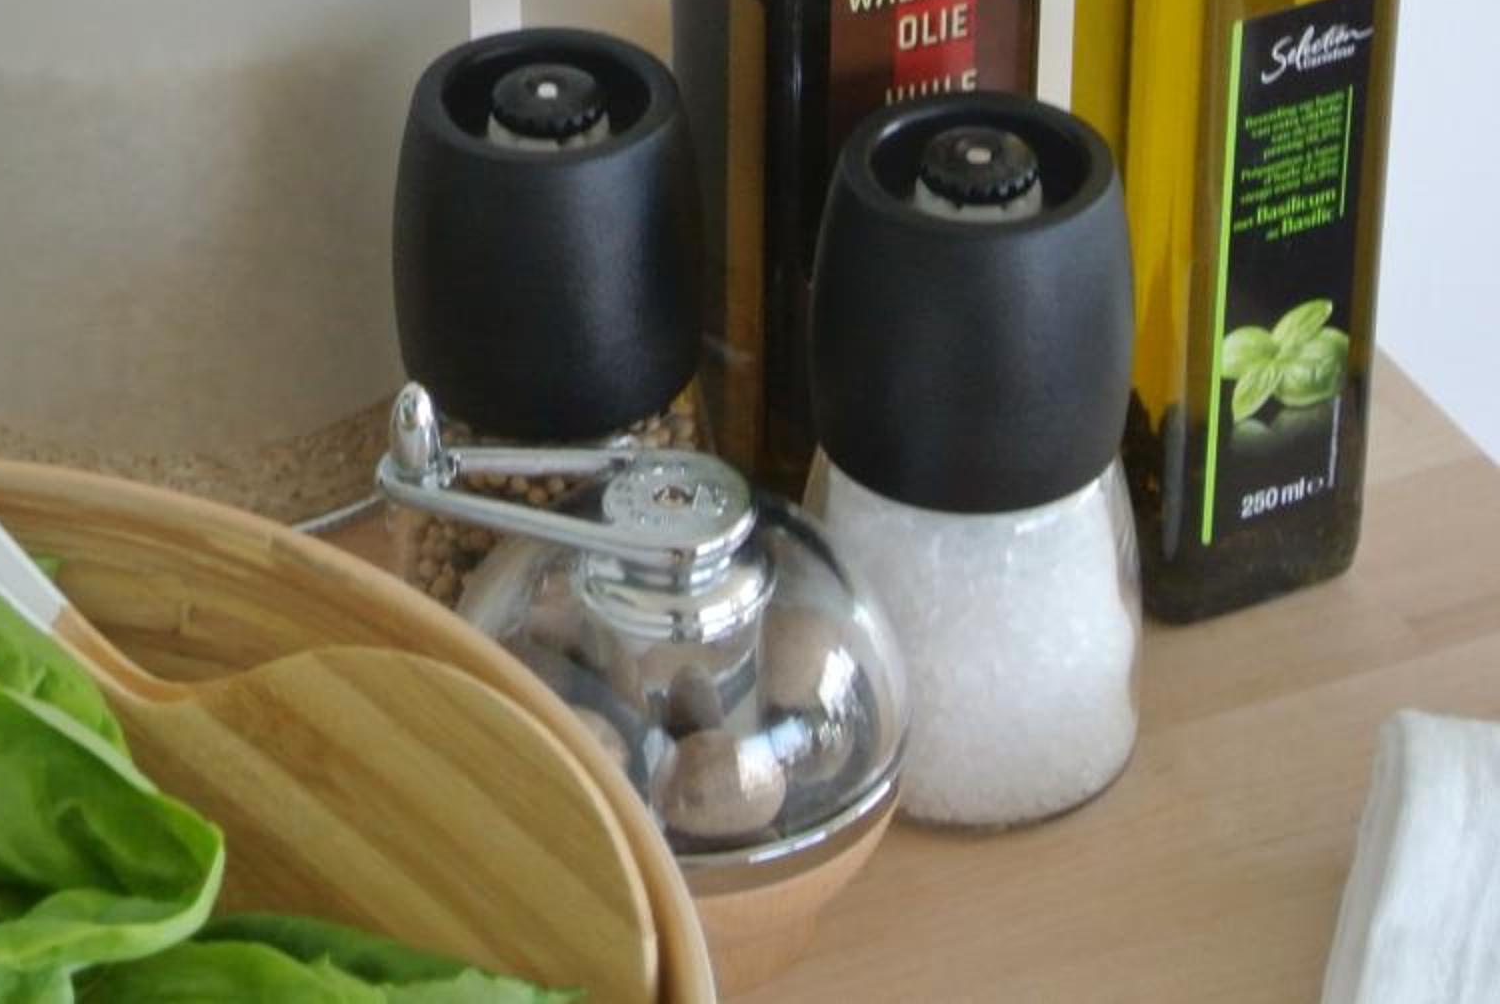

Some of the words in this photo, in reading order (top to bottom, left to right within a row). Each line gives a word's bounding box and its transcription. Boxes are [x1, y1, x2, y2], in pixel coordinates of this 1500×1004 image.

[898, 3, 969, 50] OLIE
[1240, 486, 1279, 519] 250
[1280, 476, 1305, 506] ml
